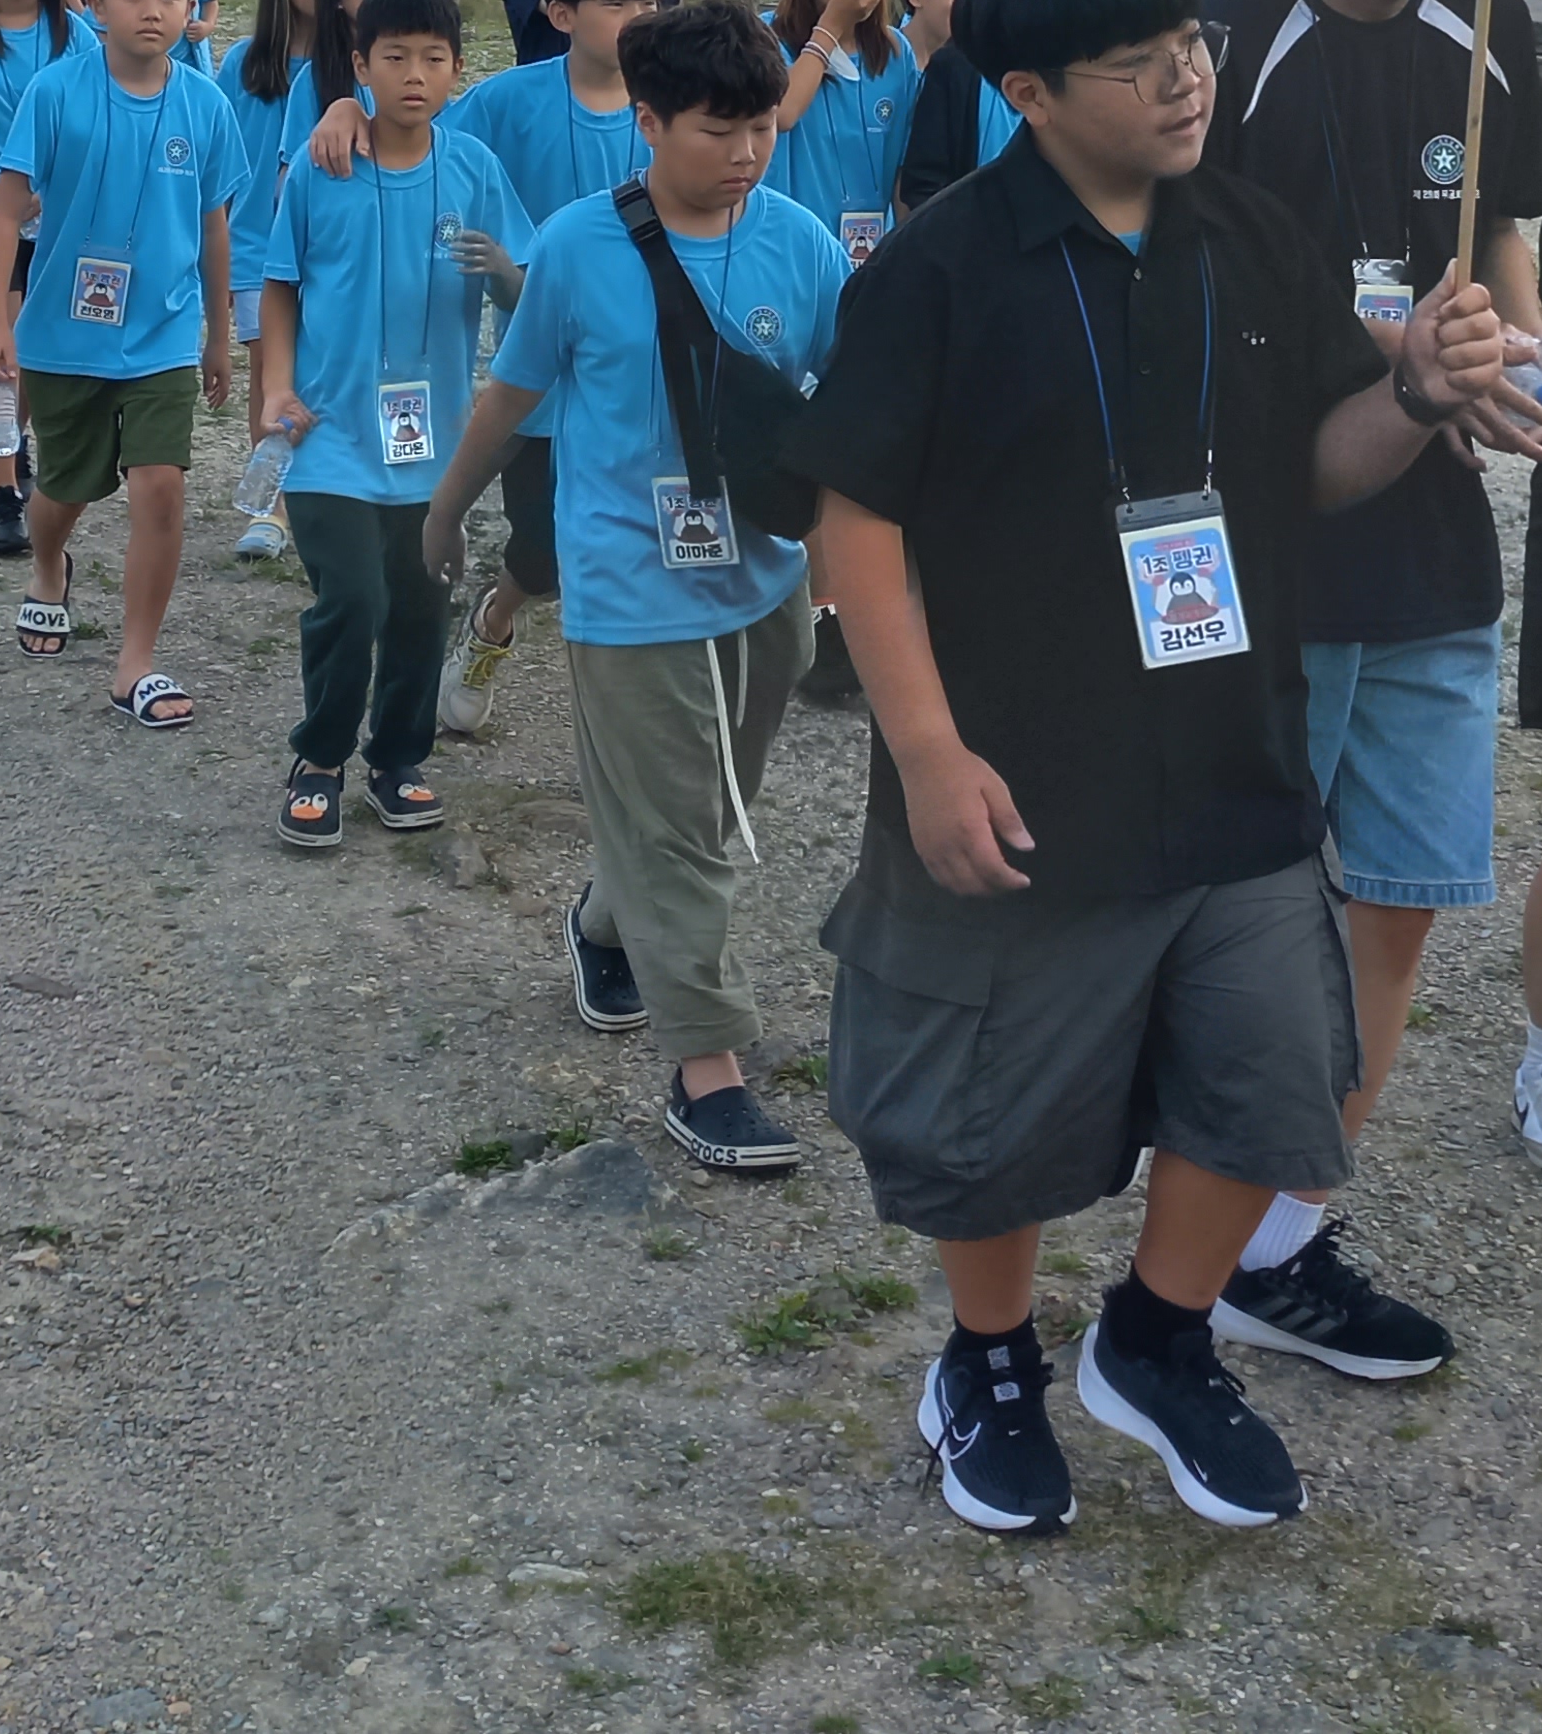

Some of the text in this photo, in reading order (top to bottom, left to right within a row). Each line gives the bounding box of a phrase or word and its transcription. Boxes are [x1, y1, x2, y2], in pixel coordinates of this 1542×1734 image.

[1142, 555, 1170, 575] 1조
[20, 605, 66, 628] MOVE
[1160, 620, 1227, 652] 김선우
[691, 1137, 738, 1165] crocs
